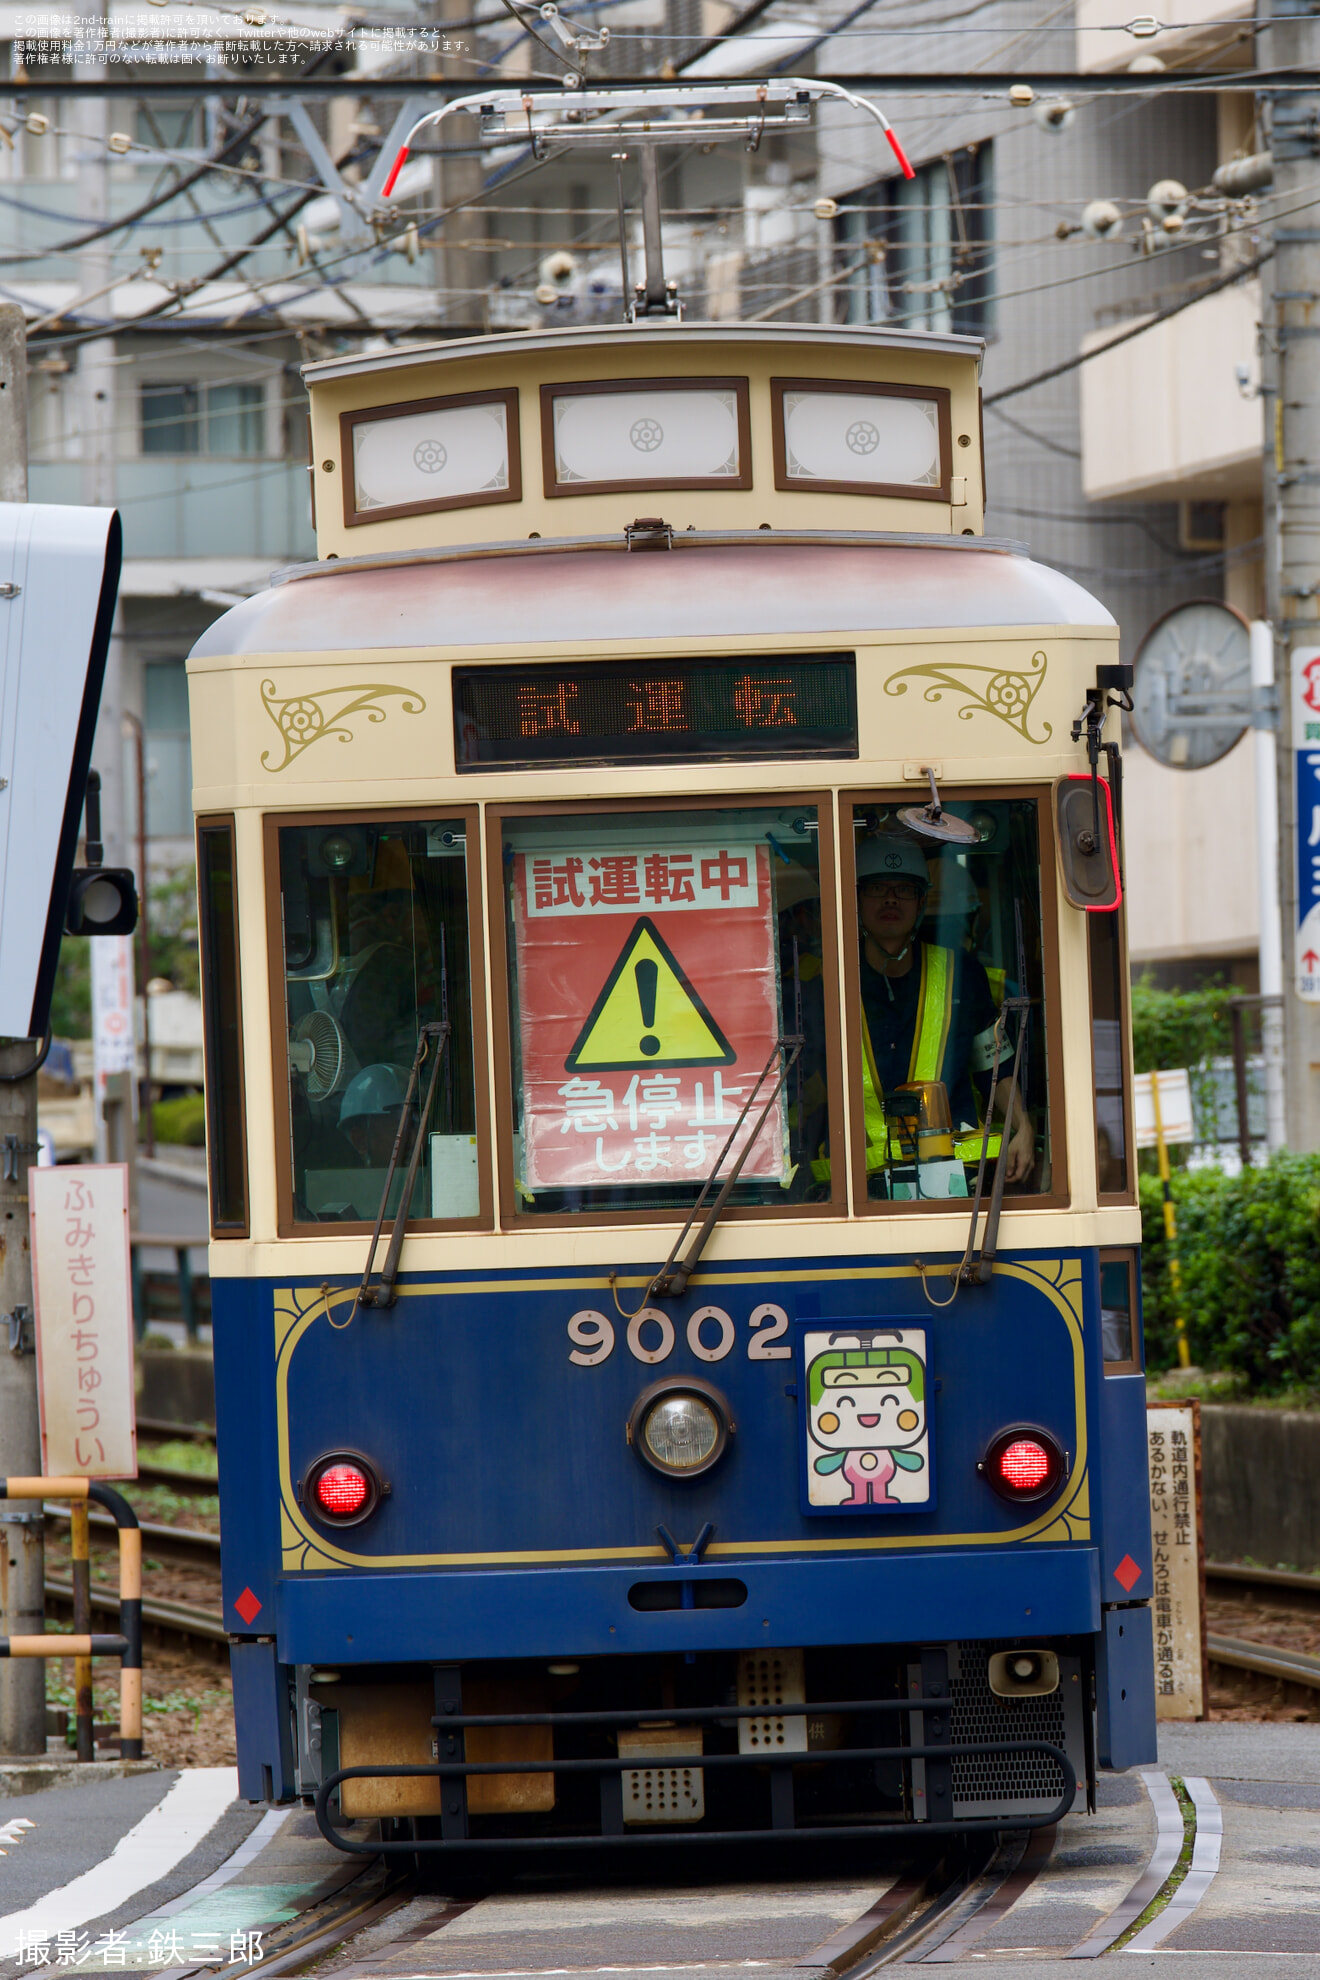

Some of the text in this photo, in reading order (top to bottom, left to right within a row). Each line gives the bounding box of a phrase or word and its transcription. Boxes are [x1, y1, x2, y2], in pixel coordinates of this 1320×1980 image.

[532, 850, 749, 910] 試運転中
[557, 1070, 747, 1134] 急停止
[595, 1129, 717, 1173] します
[64, 1179, 106, 1468] ふみきりちゅうい
[567, 1302, 792, 1367] 9002
[1170, 1429, 1192, 1546] 軌道内通行禁止
